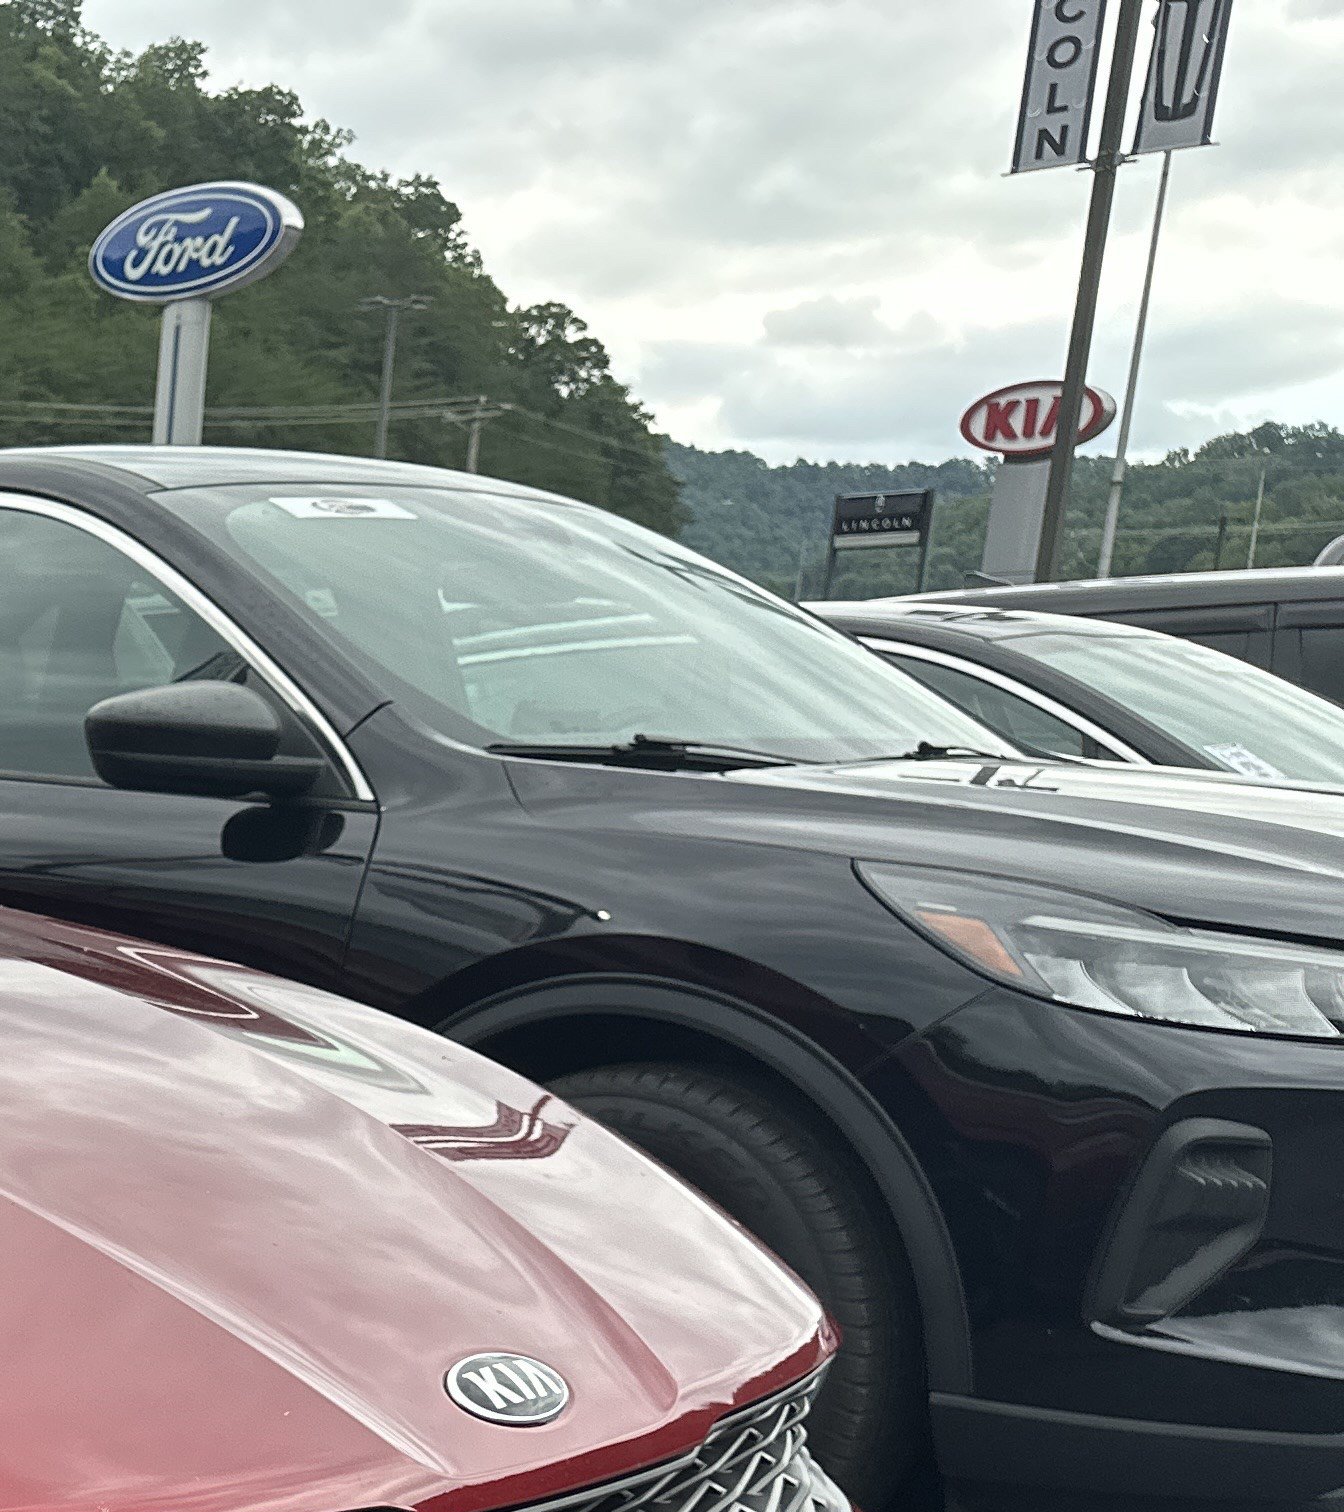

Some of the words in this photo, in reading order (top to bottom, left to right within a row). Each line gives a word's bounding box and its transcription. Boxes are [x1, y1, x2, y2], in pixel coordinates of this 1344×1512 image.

[123, 207, 240, 281] Ford
[841, 516, 912, 532] LINCOLN
[462, 1359, 562, 1410] KIA
